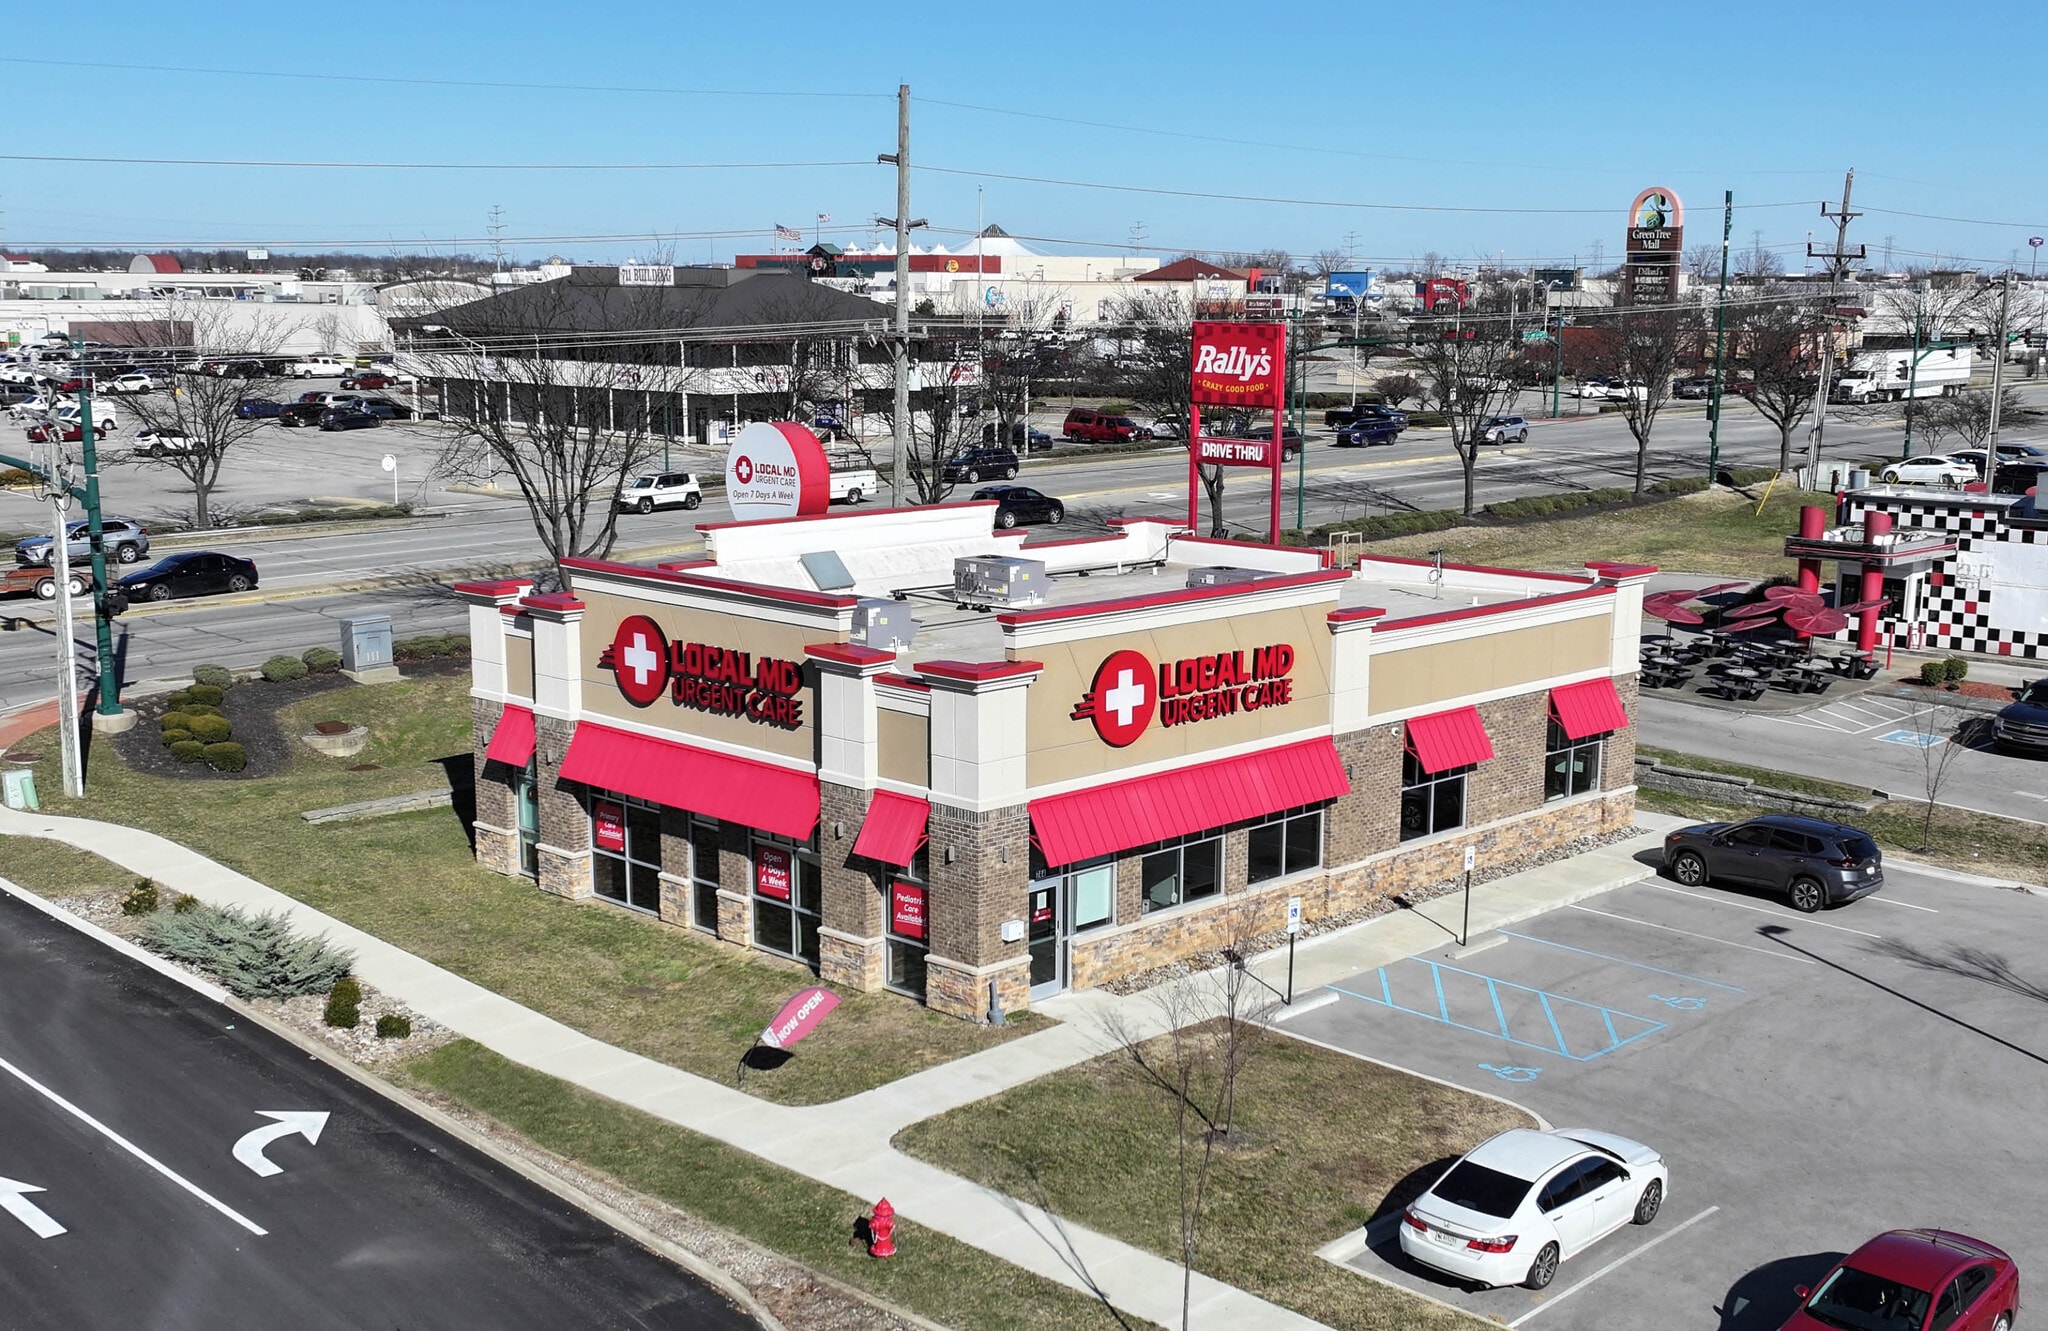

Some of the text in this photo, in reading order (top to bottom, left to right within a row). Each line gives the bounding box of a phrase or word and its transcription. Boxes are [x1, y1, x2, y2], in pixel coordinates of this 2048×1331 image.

[1632, 229, 1672, 239] Green Tree
[1642, 240, 1660, 250] Mall
[634, 268, 672, 282] BUILDING
[1194, 345, 1272, 381] Rally's
[1202, 379, 1265, 393] CRAZY GOOD FOOD
[1202, 442, 1263, 462] DRIVE THRU
[754, 463, 796, 478] LOCAL MD
[755, 475, 796, 488] URGENT CARE
[732, 490, 794, 501] Open 7 Days A Week
[671, 639, 801, 695] LOCAL MD
[1160, 643, 1295, 698] LOCAL MD
[672, 676, 804, 727] URGENT CARE
[1162, 678, 1293, 725] URGENT CARE
[600, 812, 620, 823] Primary
[604, 821, 617, 829] Care
[763, 851, 783, 863] Open
[762, 863, 786, 878] 7 Days
[760, 875, 787, 888] A Week
[896, 893, 925, 906] Pediatric
[903, 904, 919, 914] Care
[777, 990, 825, 1042] NOW OPEN!
